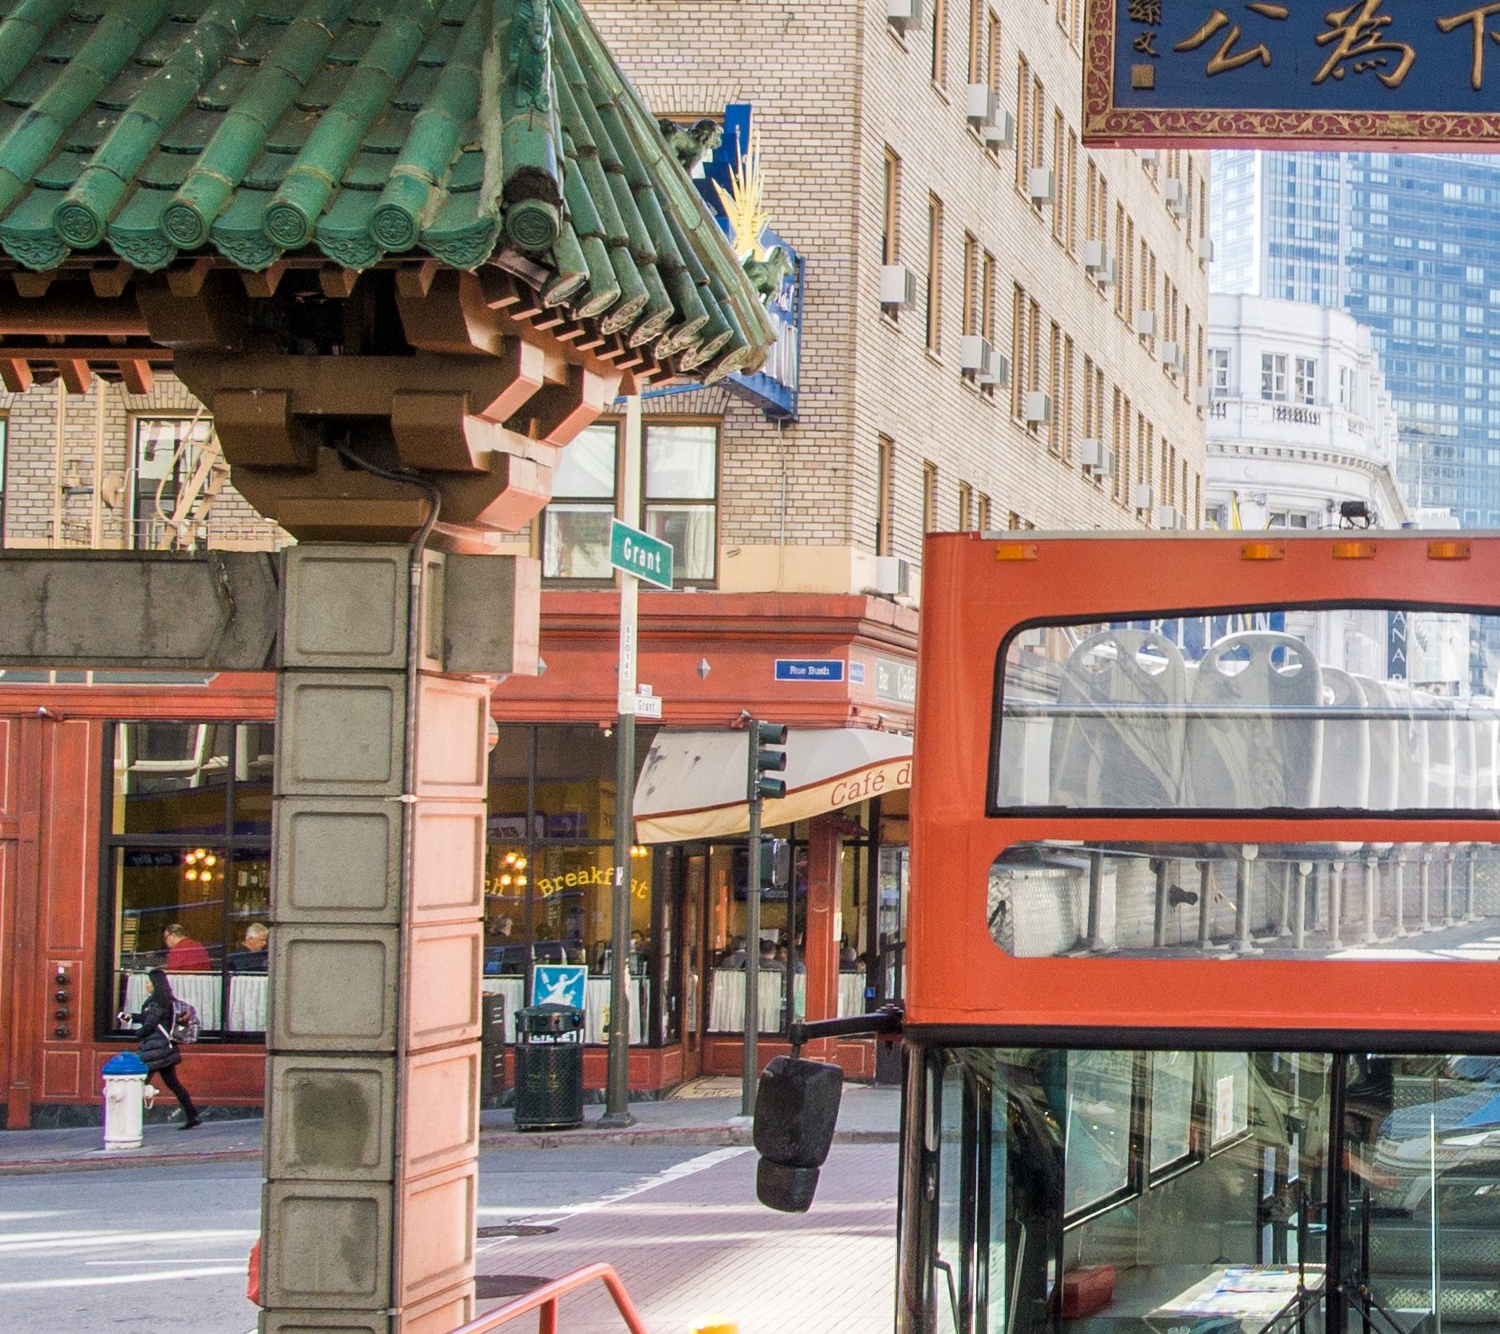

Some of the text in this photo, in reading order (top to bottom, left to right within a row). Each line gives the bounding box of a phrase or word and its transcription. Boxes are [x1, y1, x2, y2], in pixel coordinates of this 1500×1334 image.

[623, 537, 661, 574] Grant
[808, 666, 830, 676] Bush
[830, 769, 885, 806] Café
[536, 866, 649, 899] Breakfst
